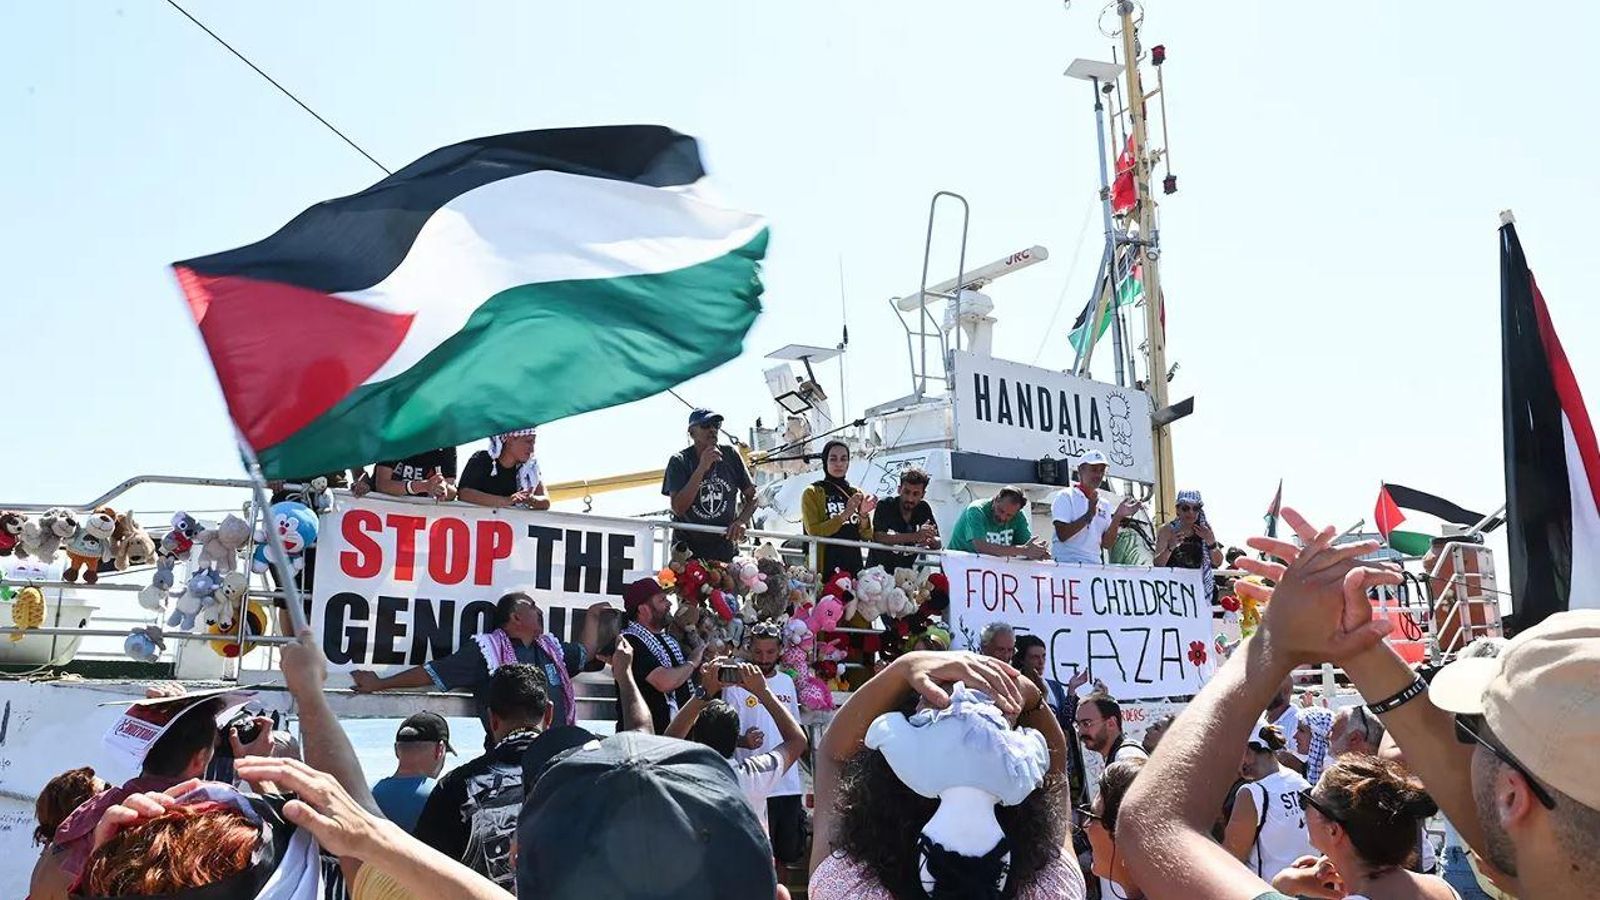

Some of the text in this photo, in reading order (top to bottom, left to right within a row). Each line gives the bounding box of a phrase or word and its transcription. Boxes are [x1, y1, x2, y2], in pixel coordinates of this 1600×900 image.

[1005, 248, 1031, 266] JRC
[973, 372, 1104, 443] HANDALA
[339, 509, 636, 596] STOP THE
[965, 568, 1199, 619] FOR THE CHILDREN
[1050, 627, 1185, 687] GAZA
[1279, 790, 1301, 810] ST
